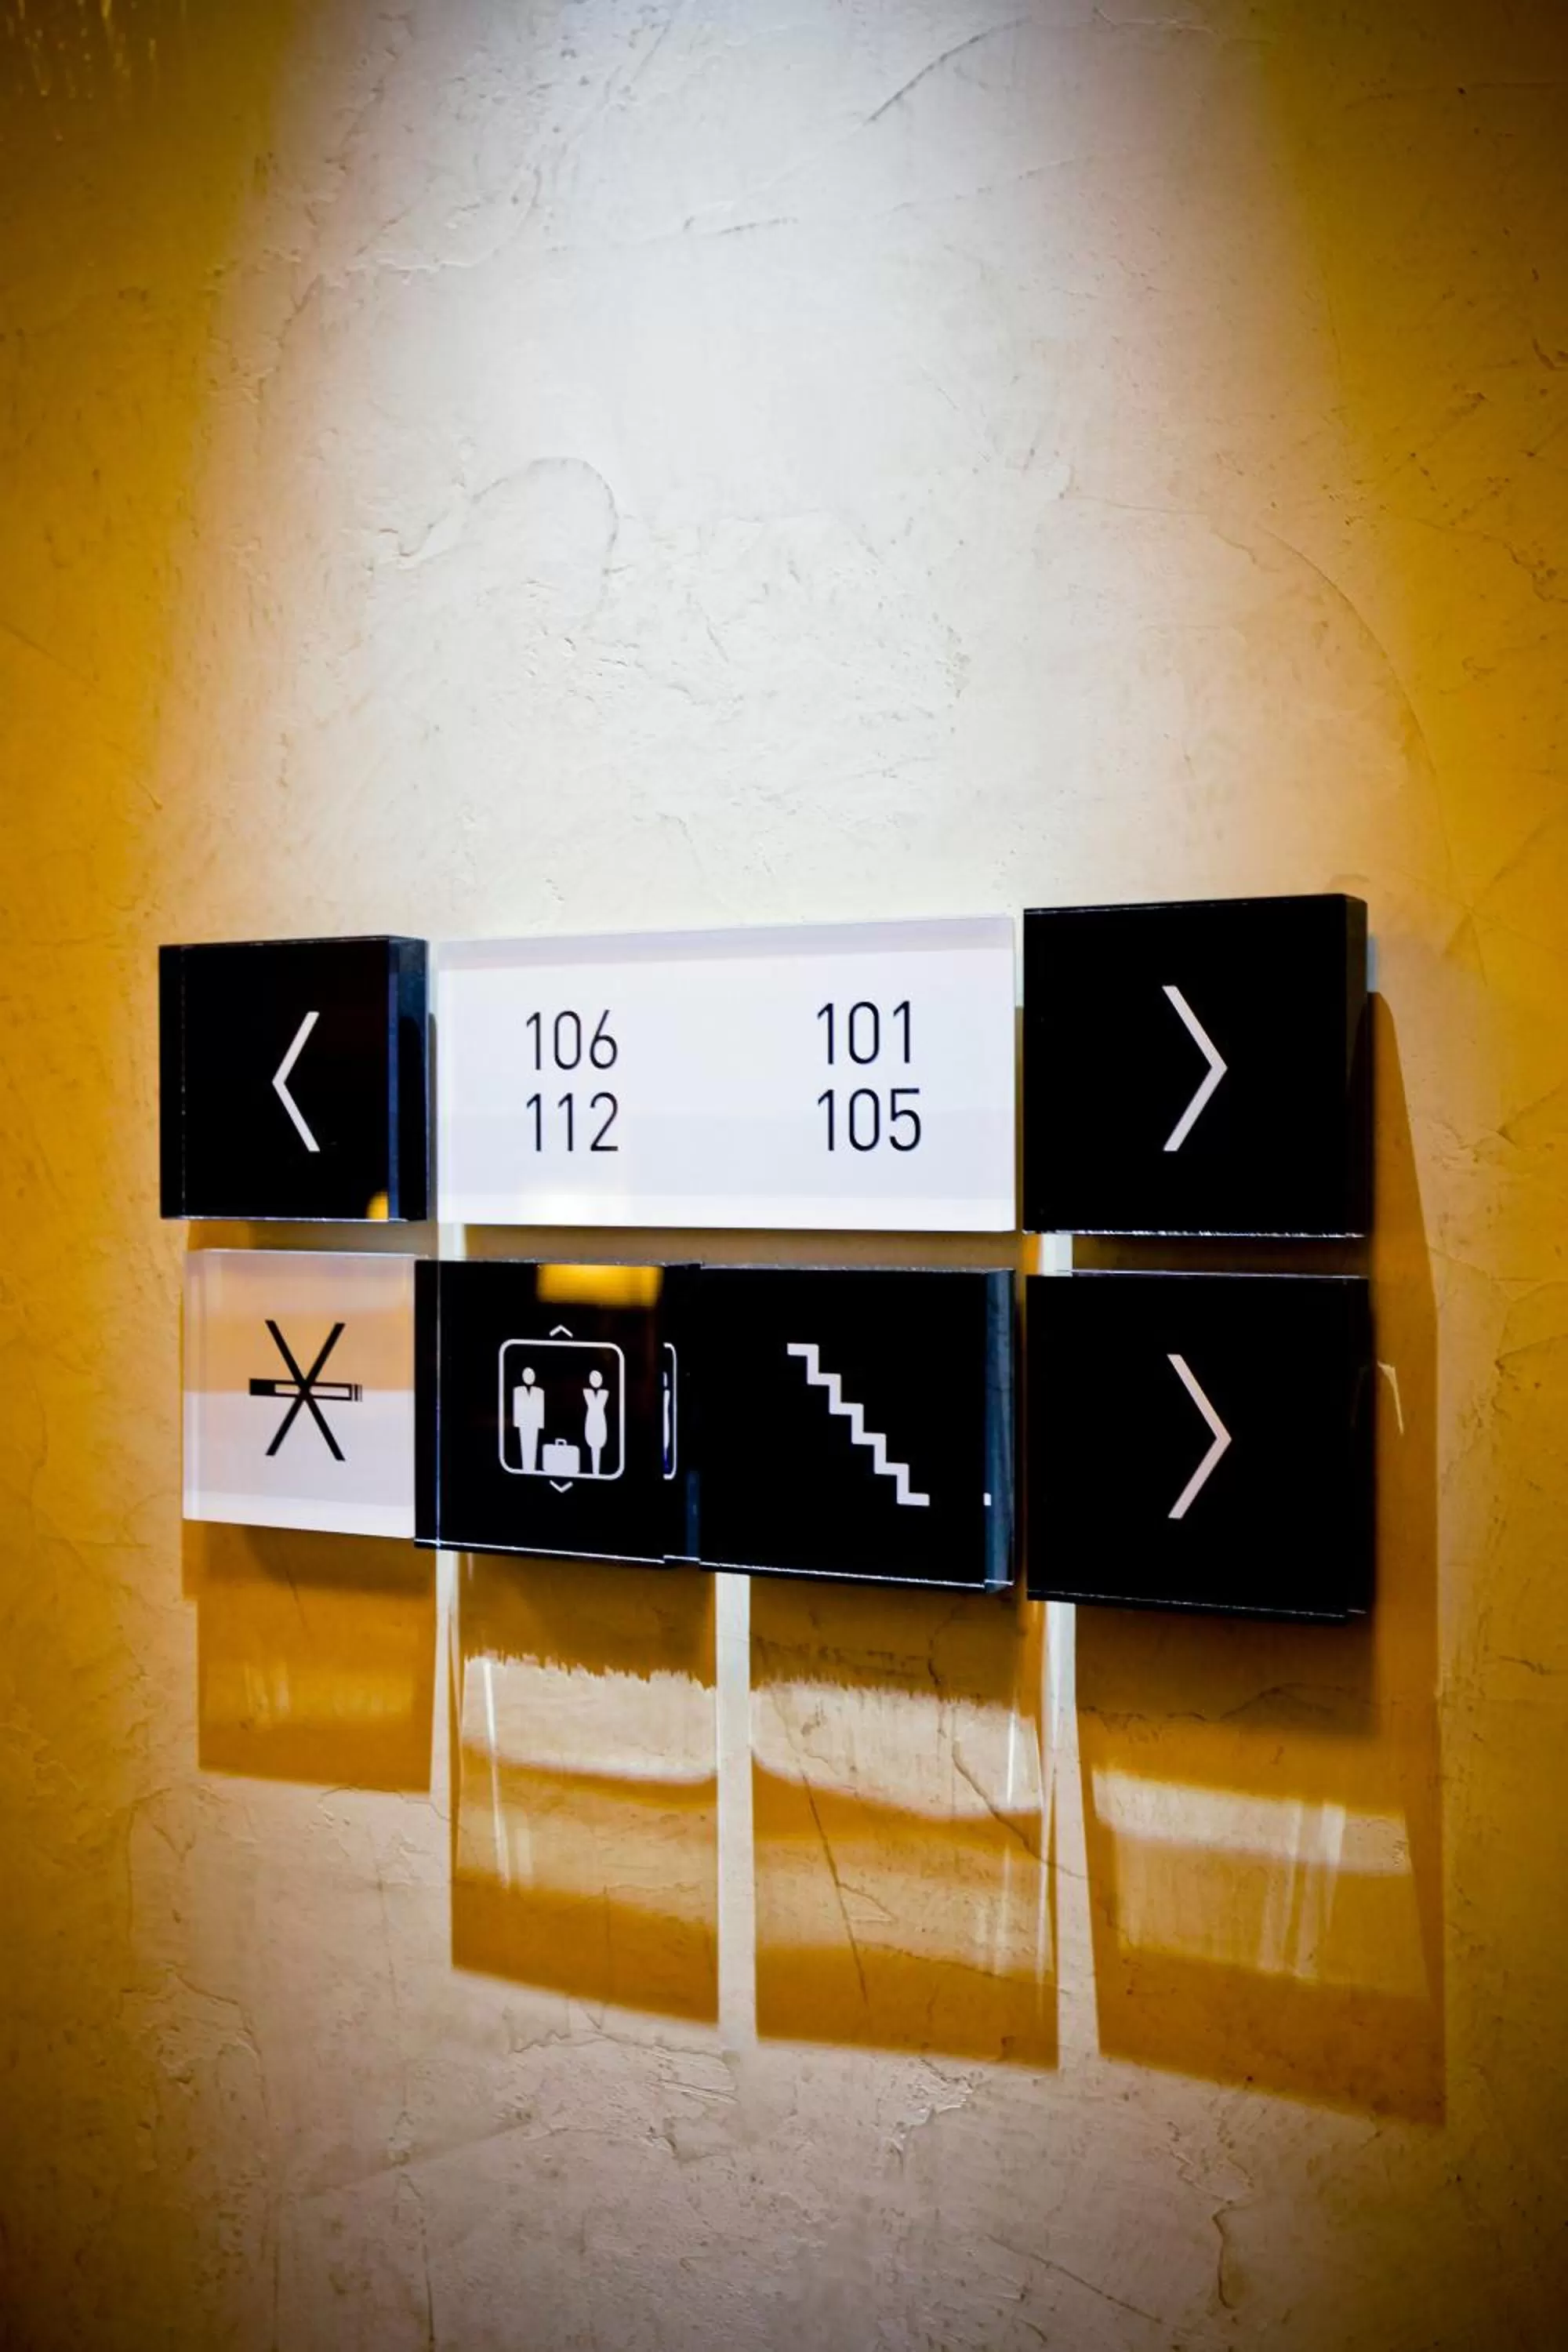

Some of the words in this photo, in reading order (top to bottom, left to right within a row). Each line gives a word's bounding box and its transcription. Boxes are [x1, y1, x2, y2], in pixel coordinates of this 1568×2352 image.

[525, 1009, 619, 1071] 106
[816, 1000, 911, 1065] 101
[525, 1091, 619, 1152] 112
[817, 1087, 922, 1152] 105
